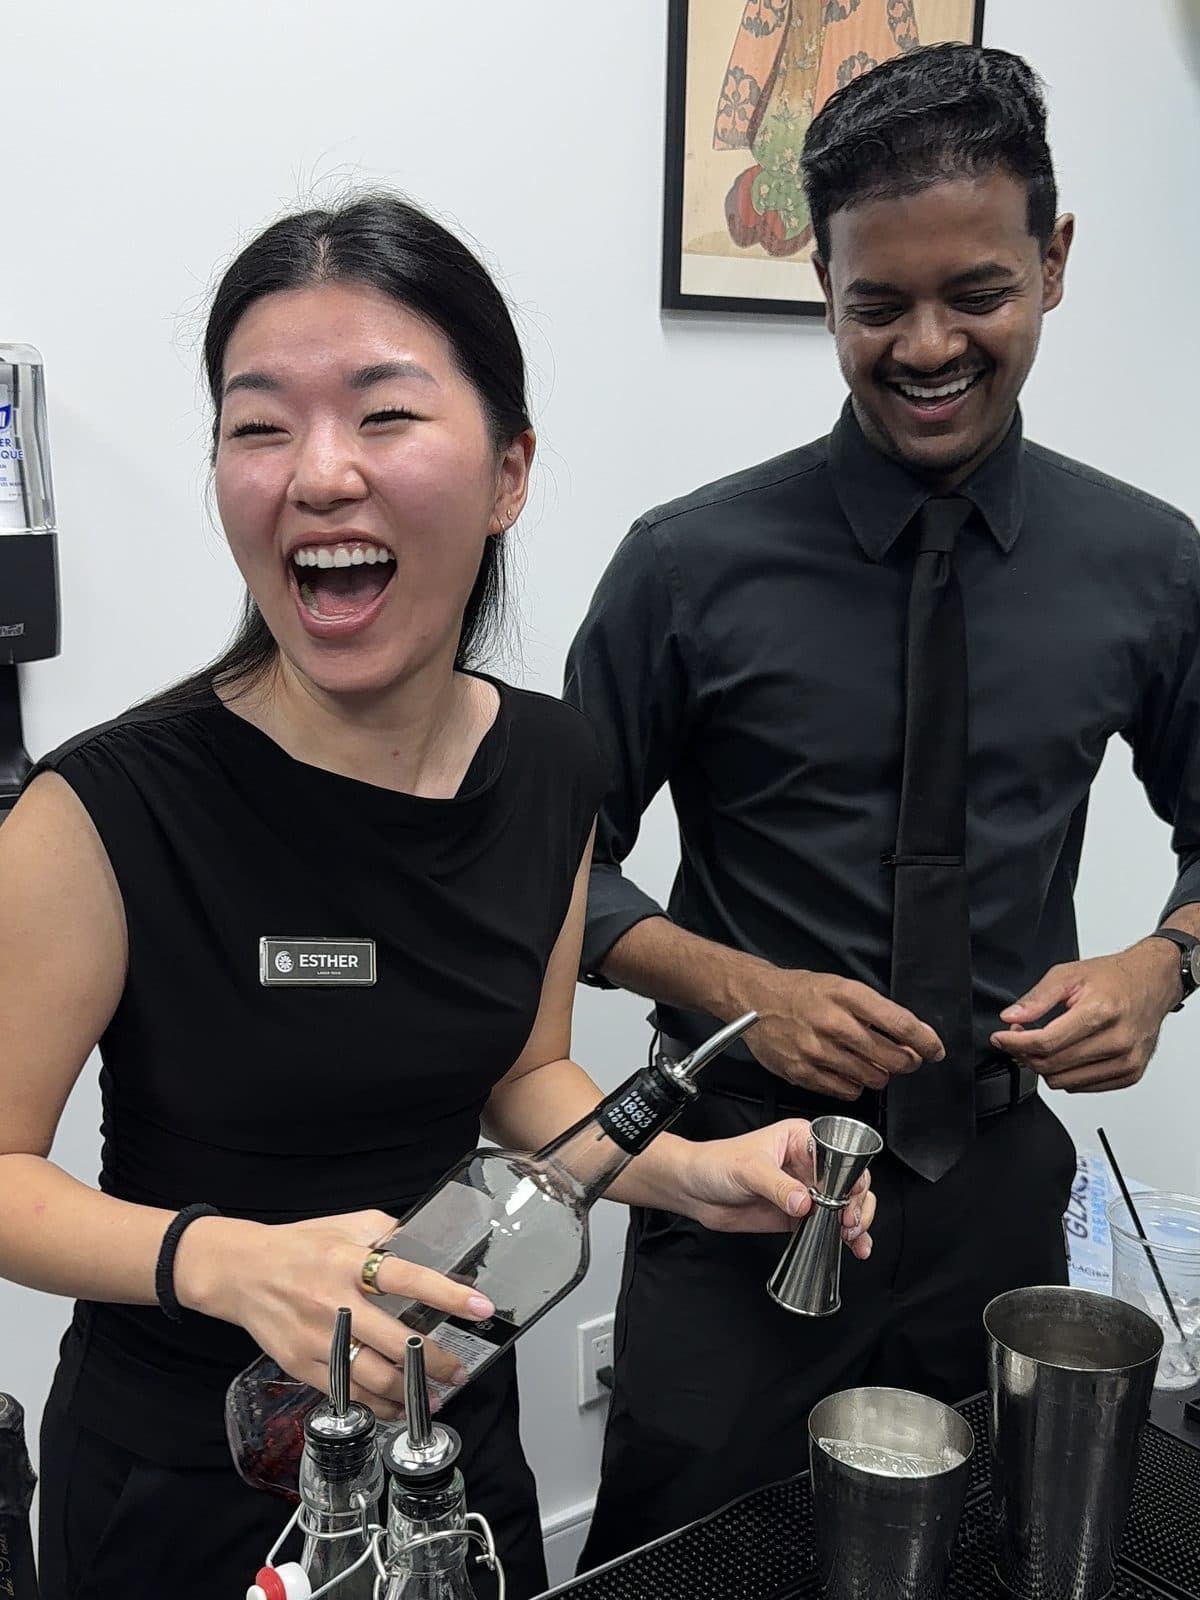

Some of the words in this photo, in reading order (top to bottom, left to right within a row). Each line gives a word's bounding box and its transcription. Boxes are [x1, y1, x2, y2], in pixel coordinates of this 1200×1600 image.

[299, 954, 359, 968] ESTHER
[612, 1106, 641, 1136] MAISON
[620, 1096, 653, 1129] 1883
